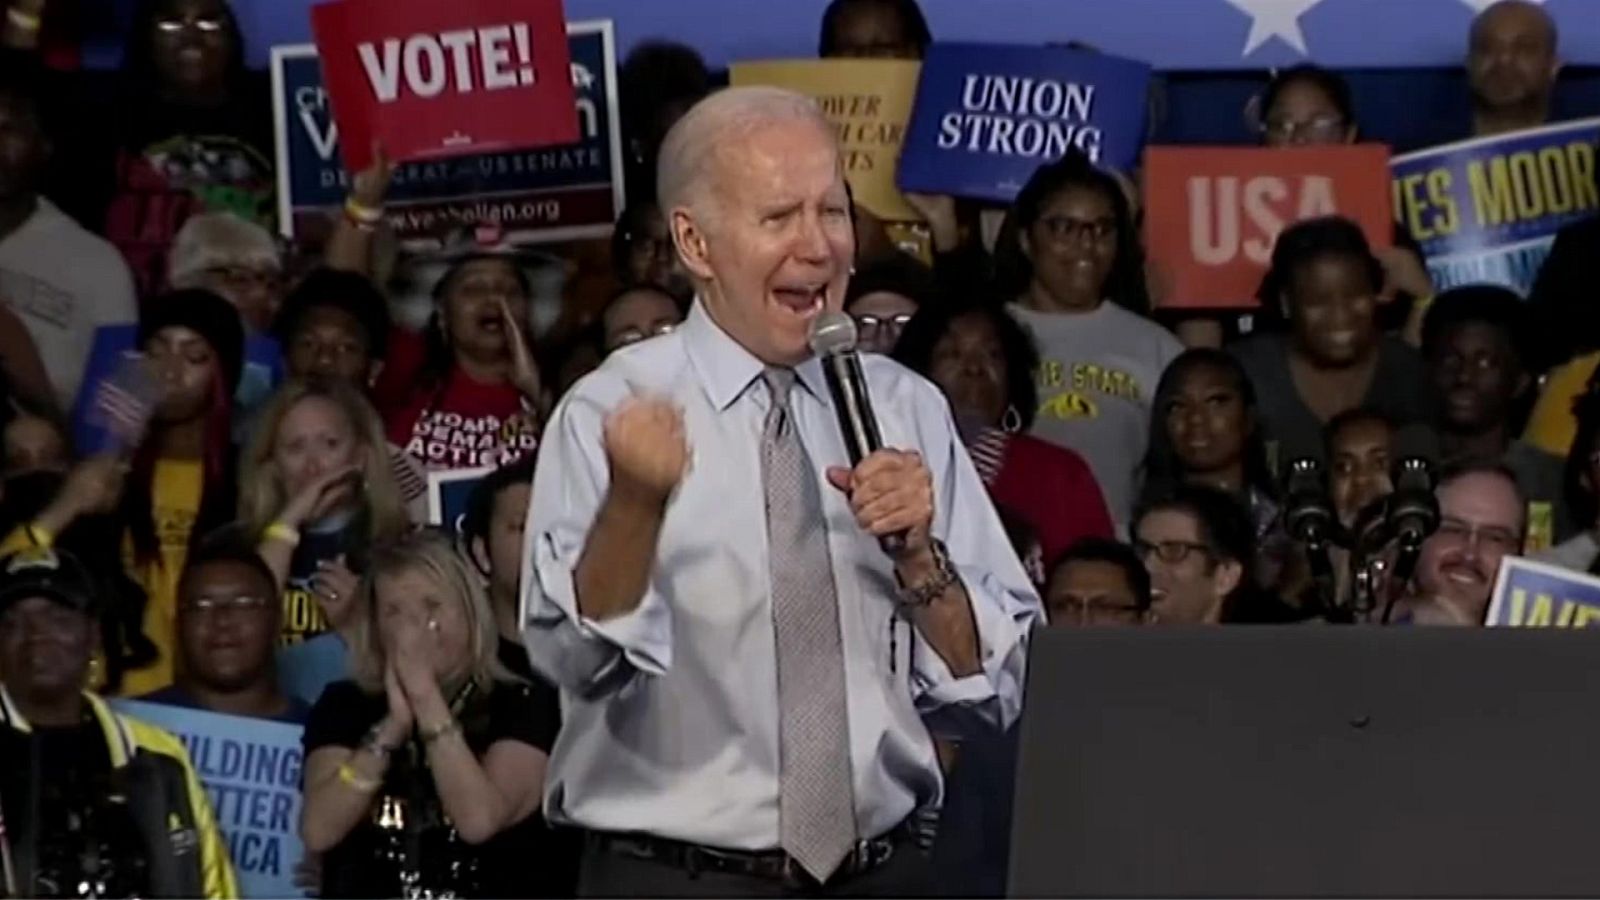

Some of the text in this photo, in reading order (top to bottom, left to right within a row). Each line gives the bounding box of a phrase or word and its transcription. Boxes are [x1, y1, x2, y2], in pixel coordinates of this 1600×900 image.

[357, 22, 536, 103] VOTE!
[962, 75, 1095, 121] UNION
[938, 113, 1102, 163] STRONG
[1468, 142, 1599, 228] MOOR
[184, 734, 300, 788] ILDING
[208, 783, 294, 833] TTER
